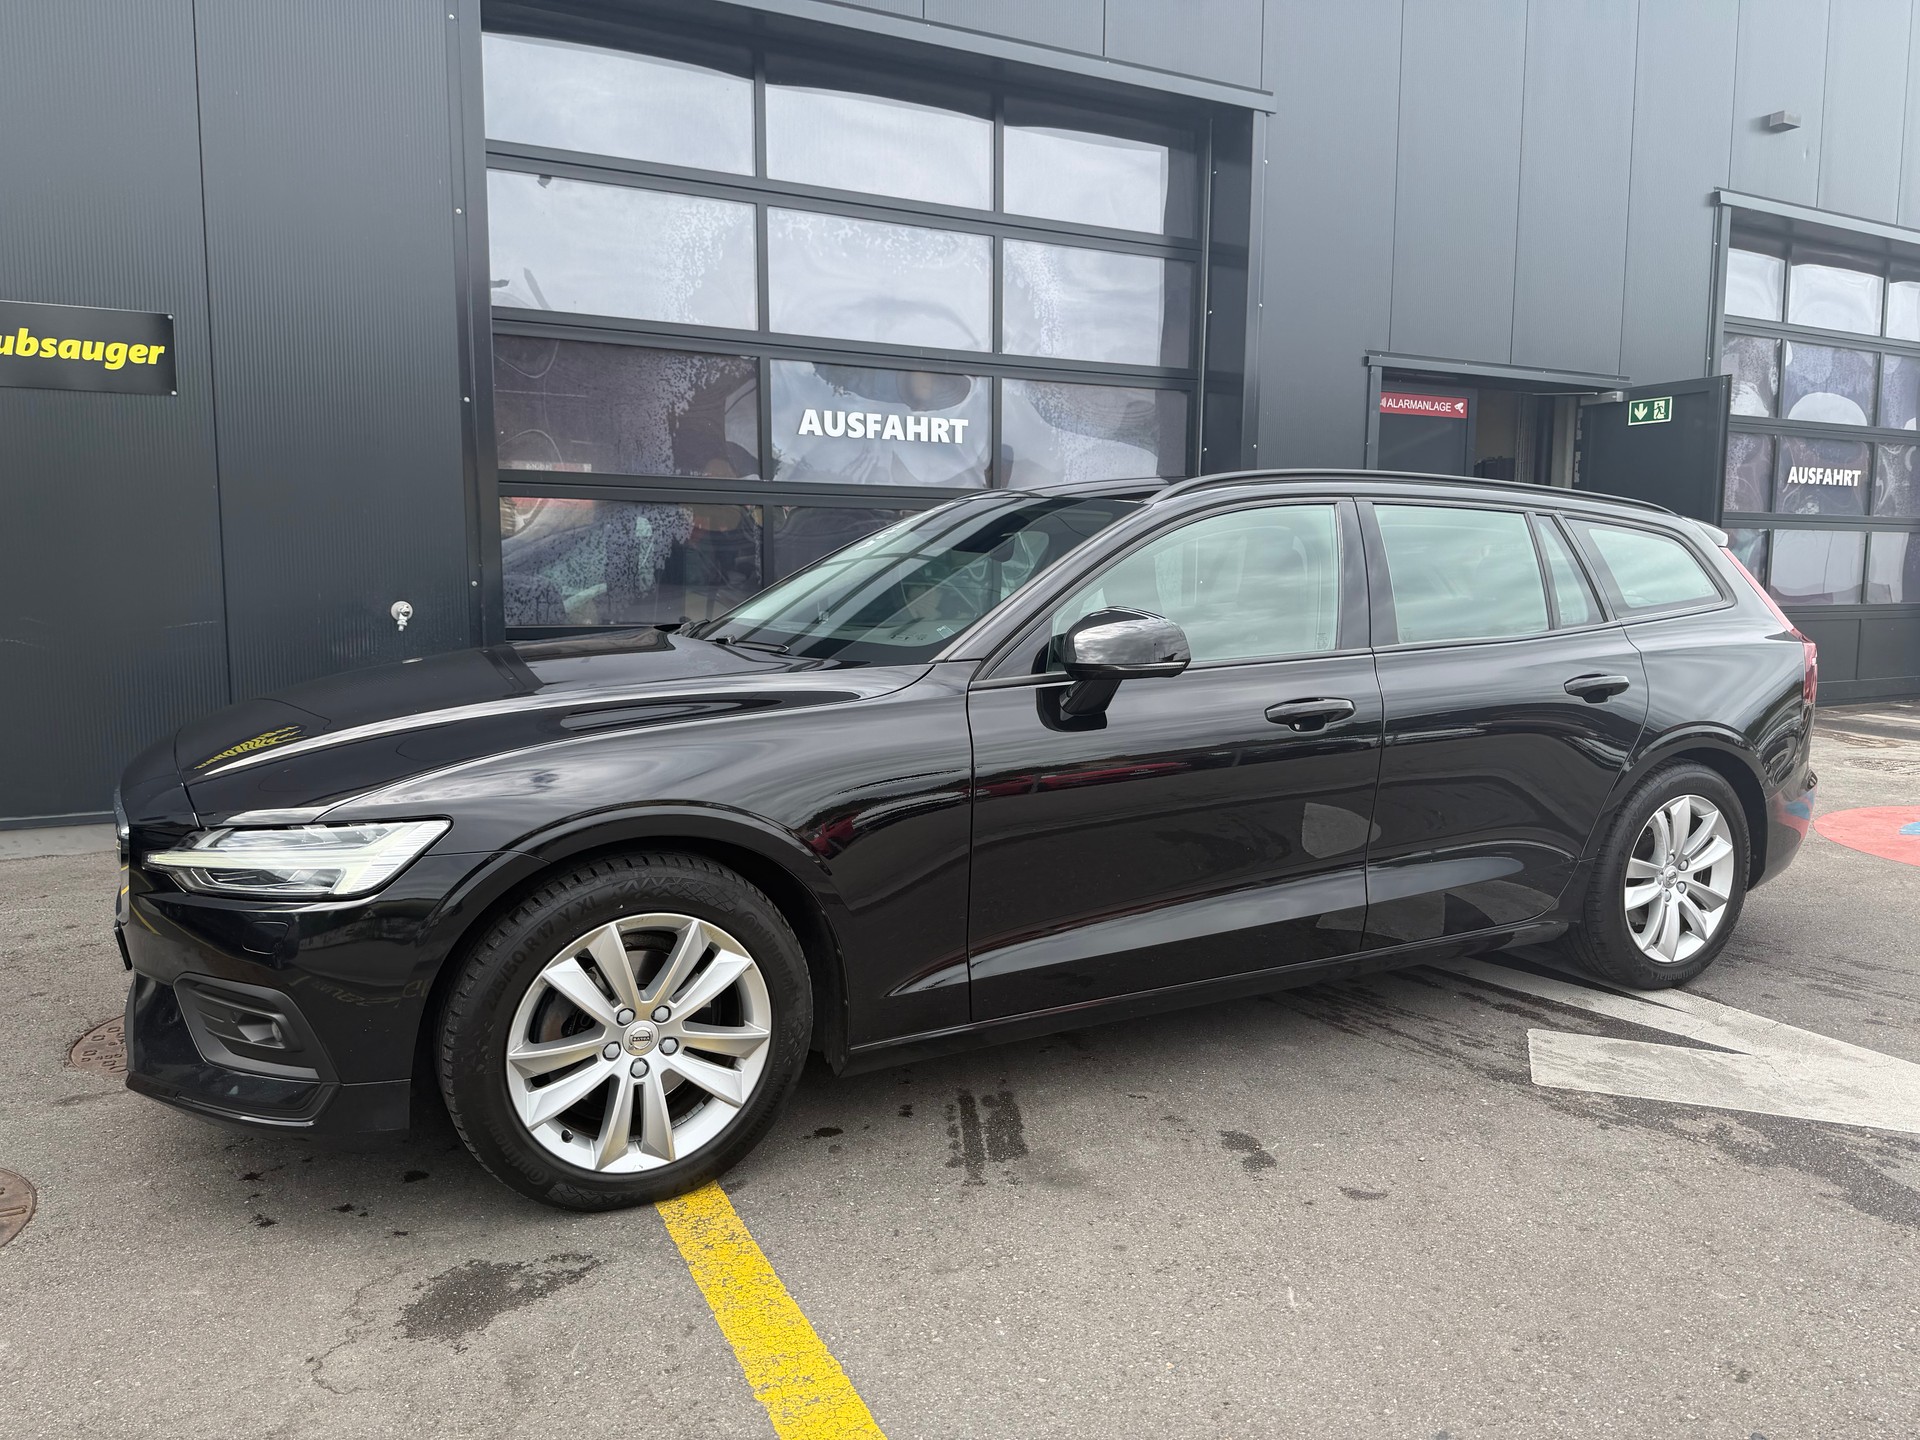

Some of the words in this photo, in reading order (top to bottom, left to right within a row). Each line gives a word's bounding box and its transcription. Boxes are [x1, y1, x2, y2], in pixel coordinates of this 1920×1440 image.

[0, 328, 165, 370] ubsauger
[1387, 398, 1451, 412] ALARMANLAGE
[799, 409, 968, 443] AUSFAHRT
[1788, 466, 1861, 486] AUSFAHRT
